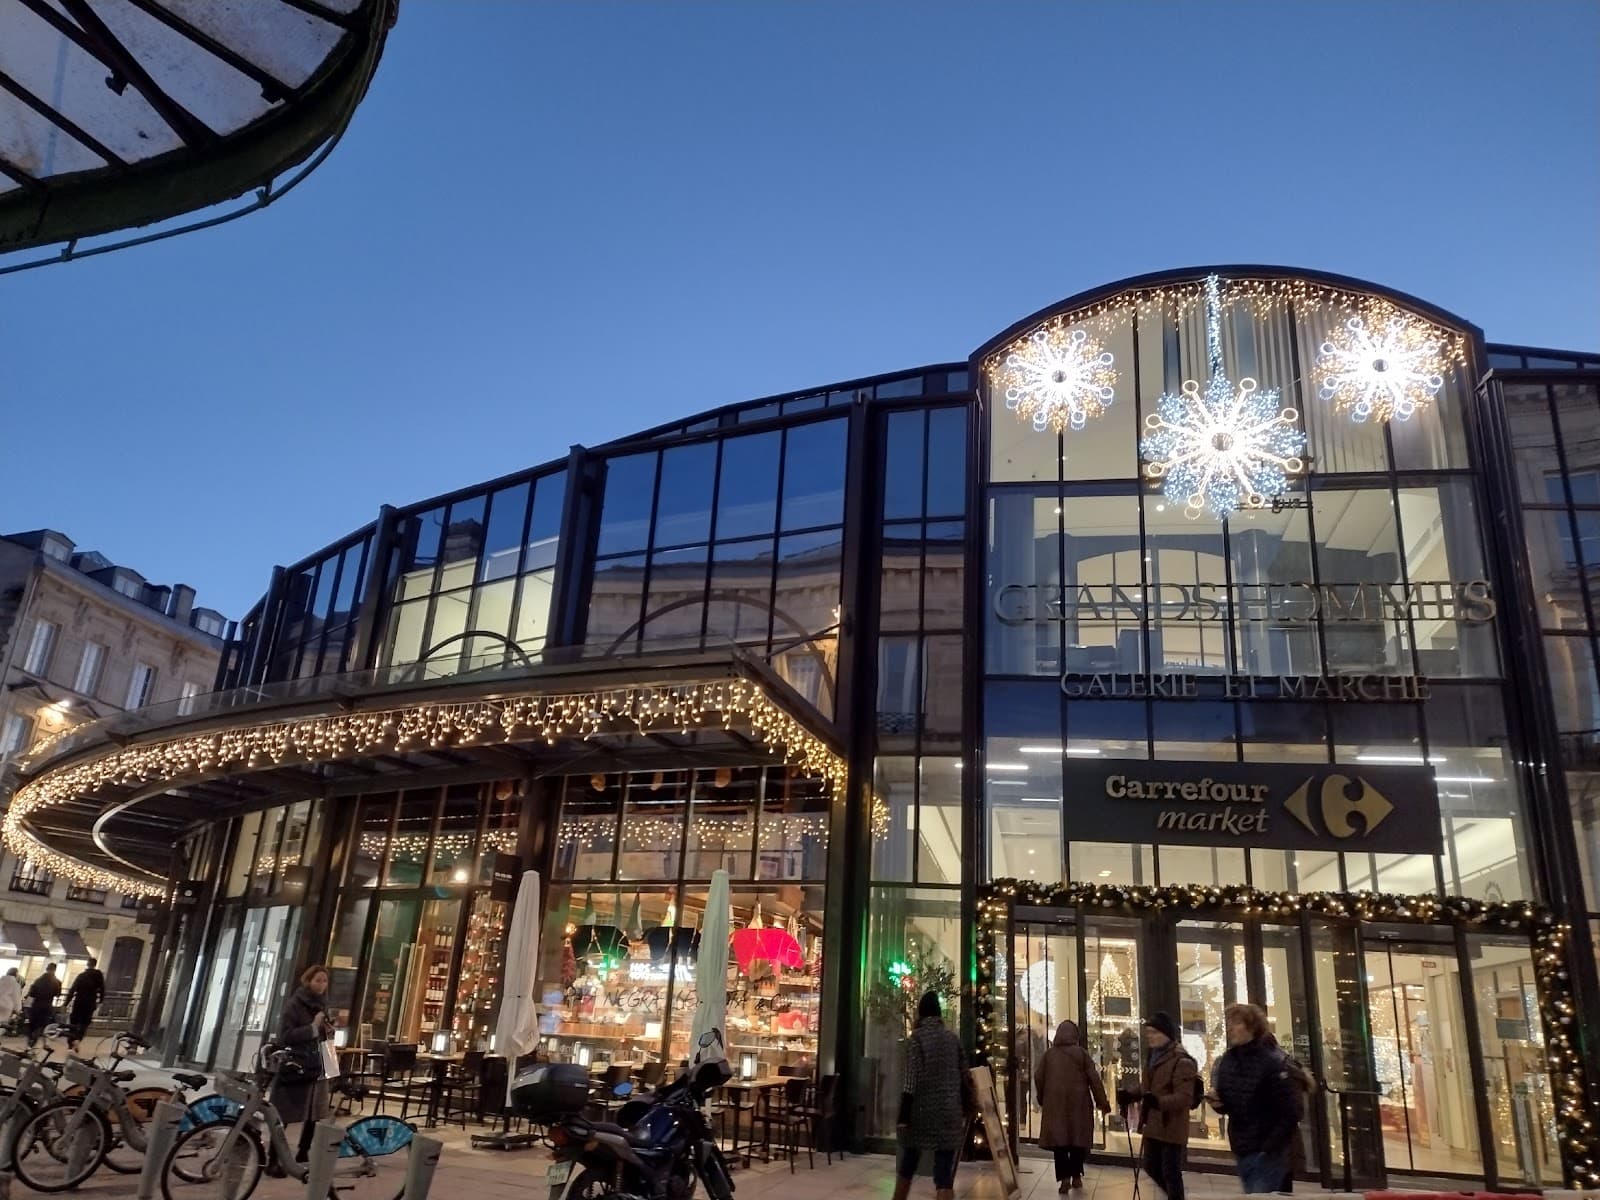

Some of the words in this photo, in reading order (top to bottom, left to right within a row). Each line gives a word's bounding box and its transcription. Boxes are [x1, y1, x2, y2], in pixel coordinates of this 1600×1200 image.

[994, 582, 1220, 626] GRANDS
[1234, 580, 1497, 625] HOMMES
[1061, 672, 1199, 697] GALERIE
[1224, 673, 1261, 698] ET
[1279, 675, 1432, 700] MARCHE
[1105, 775, 1269, 802] Carrefour
[1157, 806, 1270, 836] market
